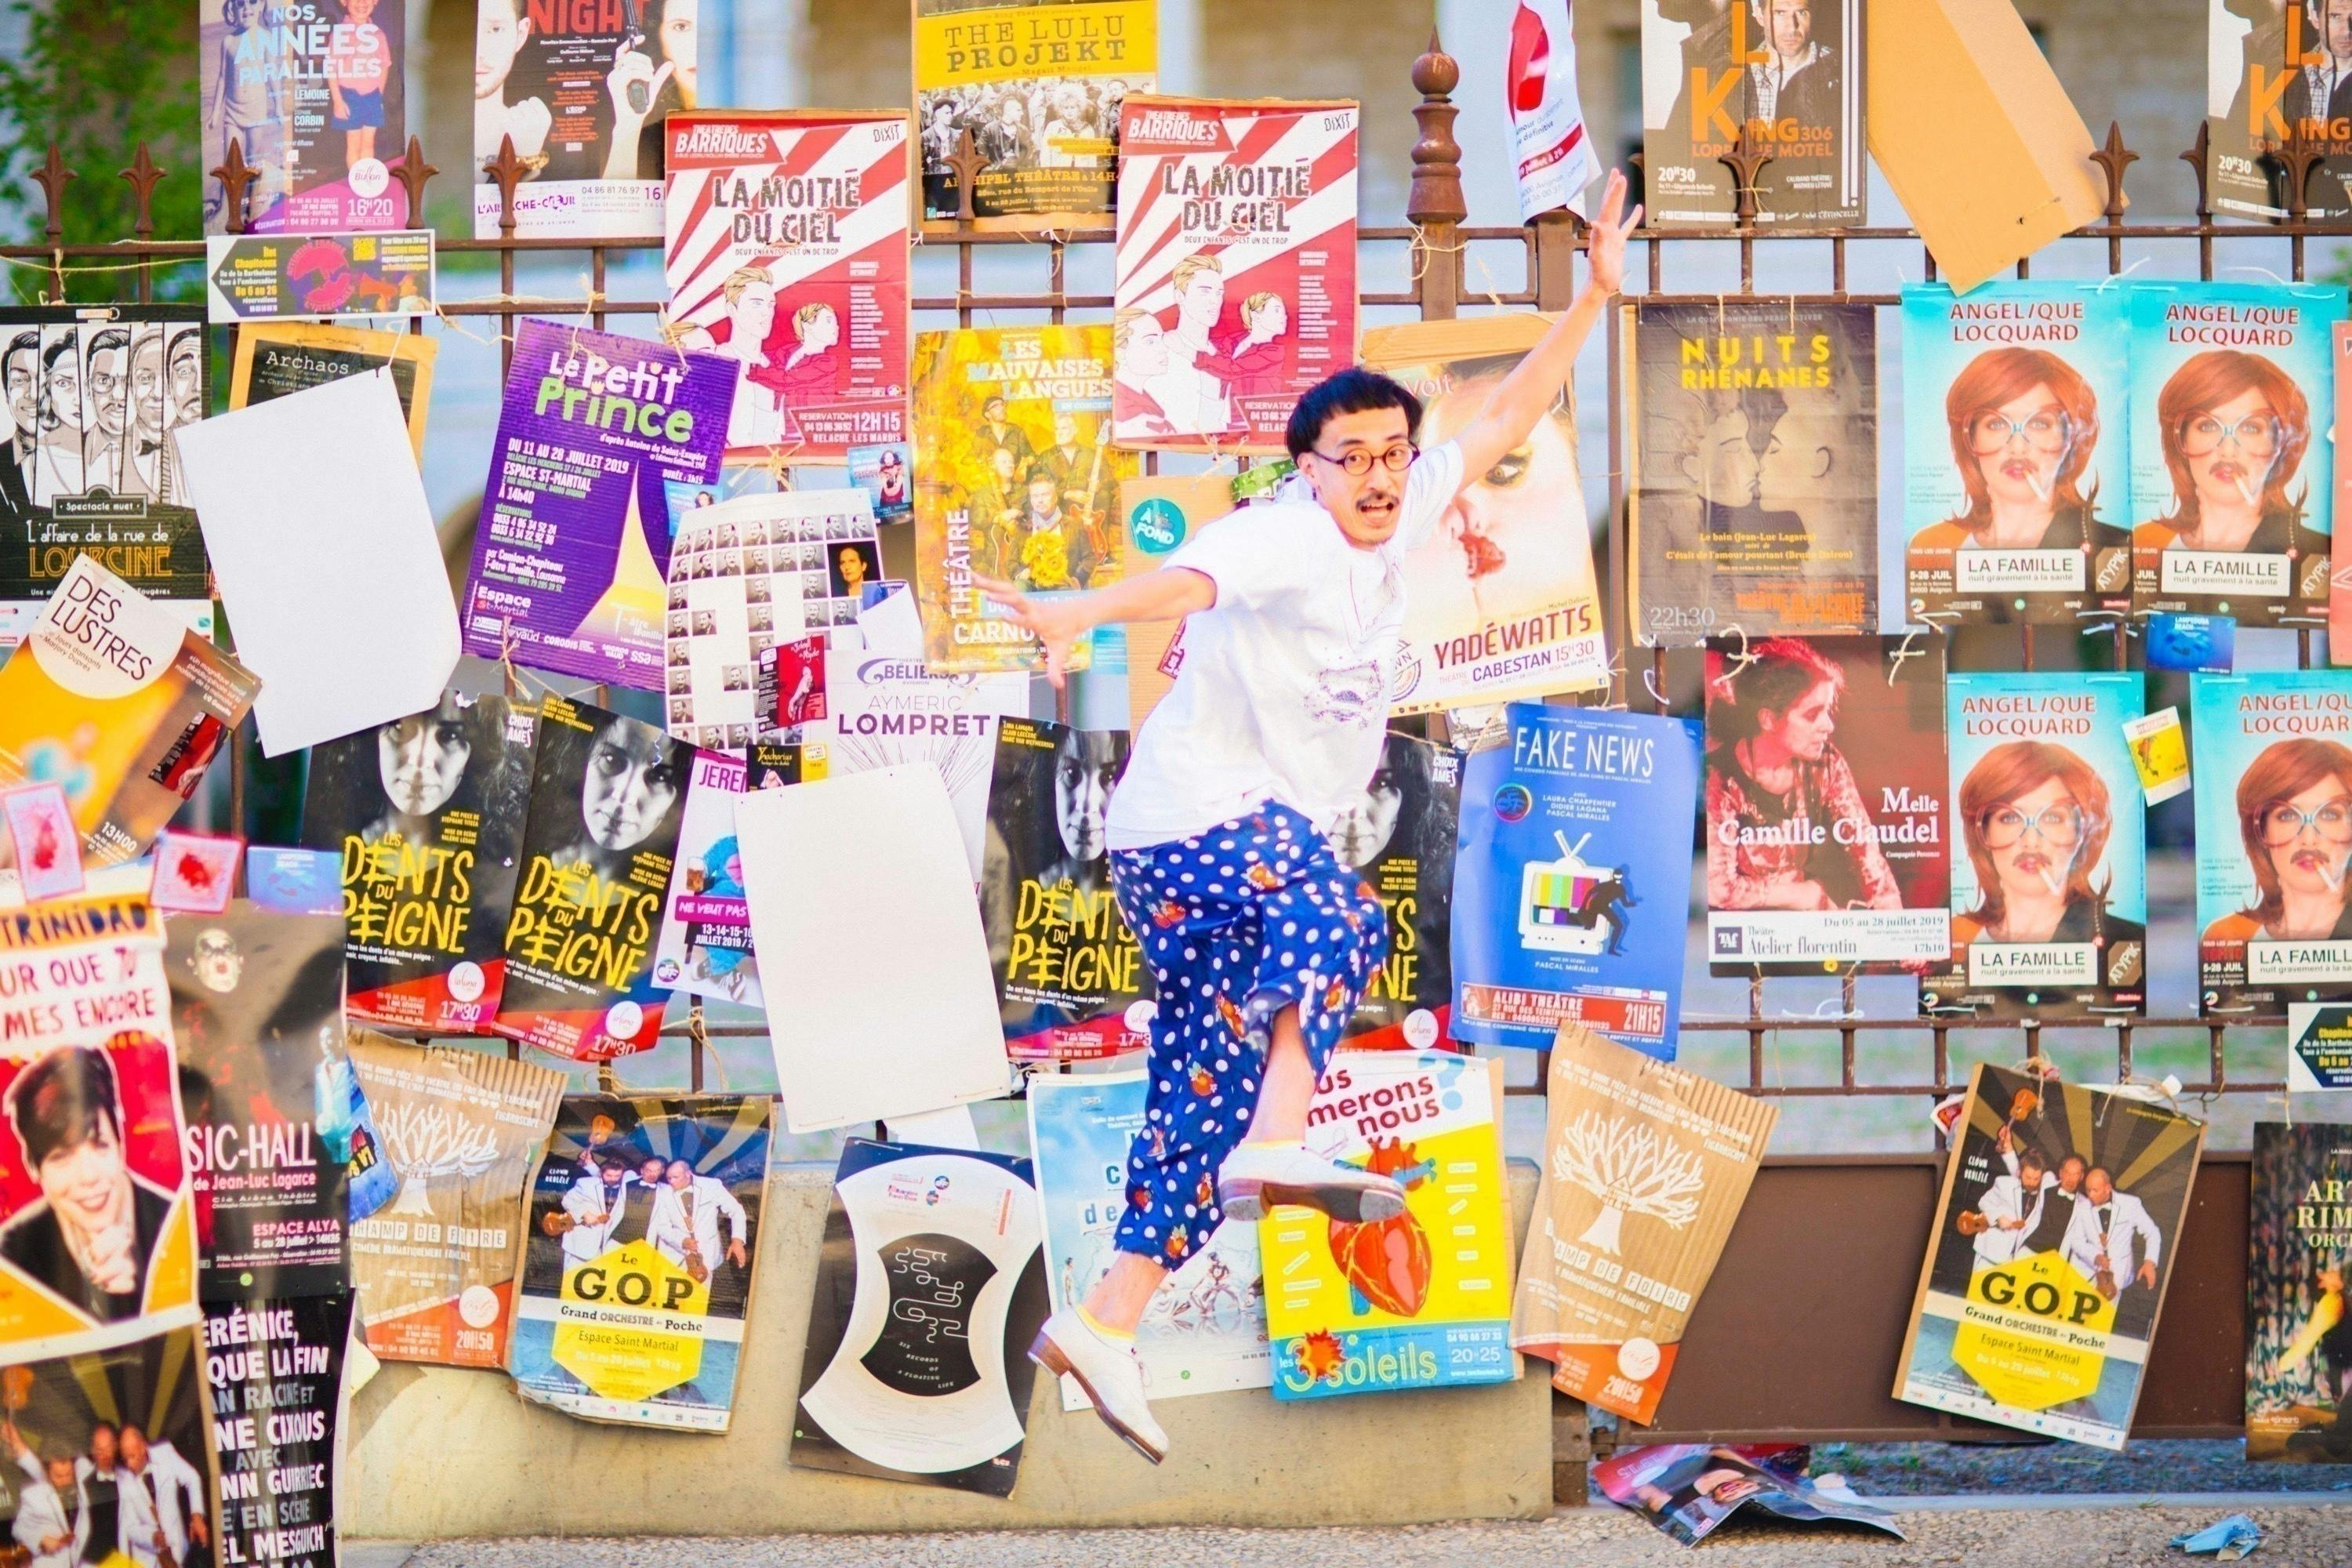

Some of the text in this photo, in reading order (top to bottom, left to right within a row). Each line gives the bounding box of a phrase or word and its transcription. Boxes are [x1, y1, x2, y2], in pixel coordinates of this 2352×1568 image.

[273, 5, 316, 23] NOS
[234, 16, 379, 64] ANNÉES
[945, 16, 1124, 48] THE LULU
[947, 40, 1126, 73] PROJEKT
[239, 54, 382, 86] PARALLÈLES
[294, 89, 330, 100] LEMOINE
[294, 115, 325, 126] CORBIN
[1128, 118, 1219, 141] BARRIQUES
[675, 133, 768, 153] BARRIQUES
[714, 168, 860, 208] LA MOITIÉ
[1165, 158, 1311, 197] LA MOITIÉ
[1184, 200, 1290, 233] DU CIEL
[734, 213, 840, 244] DU CIEL
[1954, 324, 2079, 343] LOCQUARD
[2169, 326, 2292, 346] LOCQUARD
[1002, 341, 1041, 359] LES
[1682, 335, 1830, 365] NUITS
[266, 351, 348, 374] Archaos
[967, 359, 1103, 382] MAUVAISES
[549, 352, 683, 405] Le Petit
[1682, 364, 1830, 390] RHÉNANES
[1004, 379, 1112, 400] LANGUES
[535, 377, 694, 443] Prince
[852, 412, 901, 431] 12H15
[853, 434, 868, 442] LES
[508, 437, 521, 452] DU
[524, 441, 533, 454] 11
[537, 443, 550, 456] AU
[566, 448, 603, 469] JUILLET
[604, 458, 629, 474] 2019
[662, 469, 681, 481] DURÉE
[67, 501, 133, 511] Spectacle muet
[27, 521, 168, 543] L'affaire de la rue de
[1137, 523, 1174, 544] FOND
[1700, 533, 1711, 542] Le
[1712, 533, 1732, 542] bain
[1969, 558, 1991, 572] LA
[1998, 558, 2073, 572] FAMILLE
[2174, 560, 2278, 576] LA FAMILLE
[1987, 574, 2031, 583] gravement
[2192, 576, 2235, 585] gravement
[68, 575, 122, 623] DES
[478, 586, 531, 608] Espace
[1650, 607, 1715, 627] 22h30
[50, 601, 152, 680] LUSTRES
[1434, 604, 1591, 670] YADÉWATTS
[869, 695, 962, 710] AYMERIC
[509, 714, 533, 728] CHOIX
[839, 713, 990, 735] LOMPRET
[1966, 718, 2092, 737] LOCQUARD
[1433, 755, 1459, 768] CHOIX
[1515, 727, 1654, 777] FAKE NEWS
[1882, 786, 1938, 813] Melle
[1577, 811, 1610, 821] MIRALLES
[101, 822, 138, 853] 13H00
[1718, 816, 1940, 846] Camille Claudel
[341, 836, 474, 902] DENTS
[376, 884, 394, 899] DU
[1059, 877, 1073, 892] LES
[519, 855, 659, 945] DENTS
[678, 902, 746, 917] NE VEUT PAS
[554, 910, 575, 927] DU
[1824, 918, 1838, 927] Du
[1872, 917, 1884, 926] 28
[1886, 916, 1916, 927] juillet
[1919, 916, 1943, 926] 2019
[695, 935, 741, 947] JUILLET 2019
[1053, 928, 1068, 945] DU
[1008, 933, 1141, 992] PEIGNE
[1535, 961, 1599, 973] PASCAL MIRALLES
[1981, 952, 2085, 967] LA FAMILLE
[2260, 951, 2282, 963] LA
[2279, 964, 2323, 973] gravement
[1624, 1004, 1661, 1032] 21H15
[1968, 1155, 1988, 1169] CLOWN
[194, 1172, 315, 1191] de Jean-Luc Lagarce
[253, 1219, 340, 1236] ESPACE ALYA
[621, 1254, 637, 1265] Le
[2032, 1262, 2049, 1274] Le
[561, 1305, 702, 1332] Grand ORCHESTRE Poche
[1965, 1305, 2106, 1348] Grand ORCHESTRE Poche
[579, 1330, 678, 1351] Espace Saint Martial
[1981, 1334, 2081, 1365] Espace Saint Martial
[206, 1347, 328, 1388] QUE LA FIN
[245, 1383, 314, 1410] RACINE ET
[236, 1448, 281, 1471] AVEC
